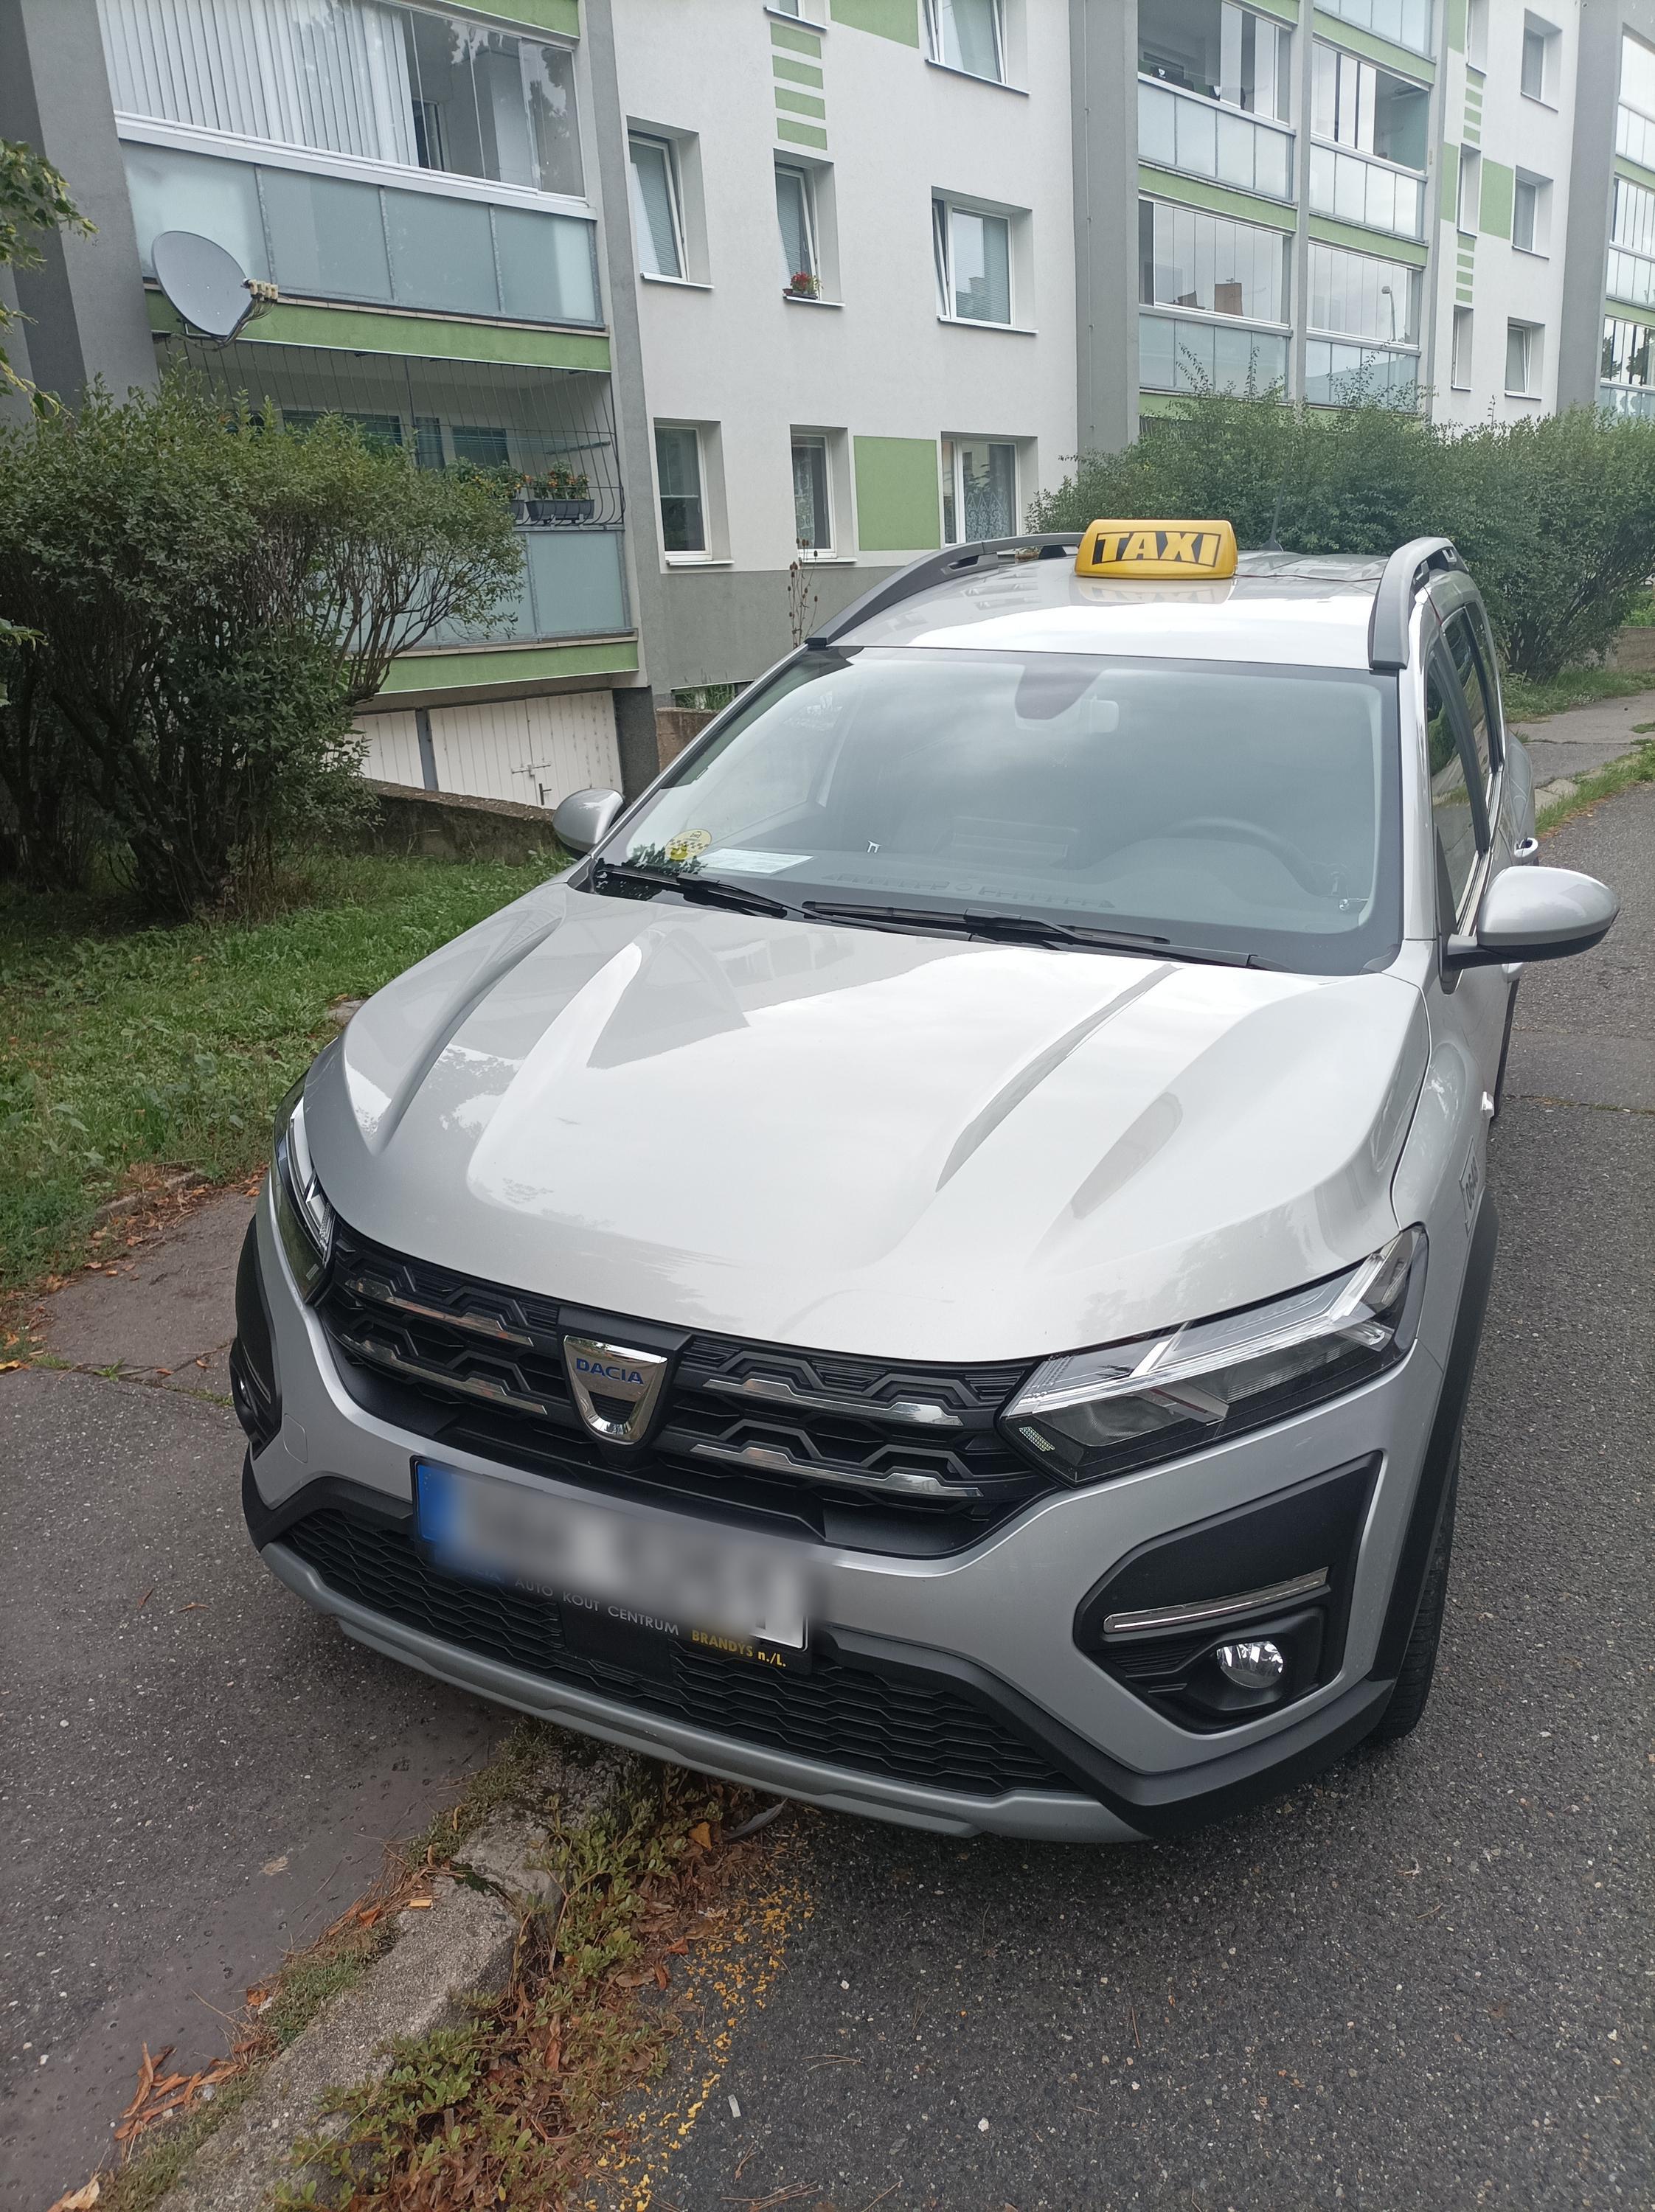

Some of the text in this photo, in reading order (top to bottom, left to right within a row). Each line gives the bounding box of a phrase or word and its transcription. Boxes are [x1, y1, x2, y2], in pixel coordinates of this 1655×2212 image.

[1094, 531, 1221, 566] TAXI
[576, 1357, 645, 1385] DACIA
[515, 1576, 553, 1597] AUTO
[563, 1590, 600, 1612] KOUT
[607, 1605, 679, 1636] CENTRUM
